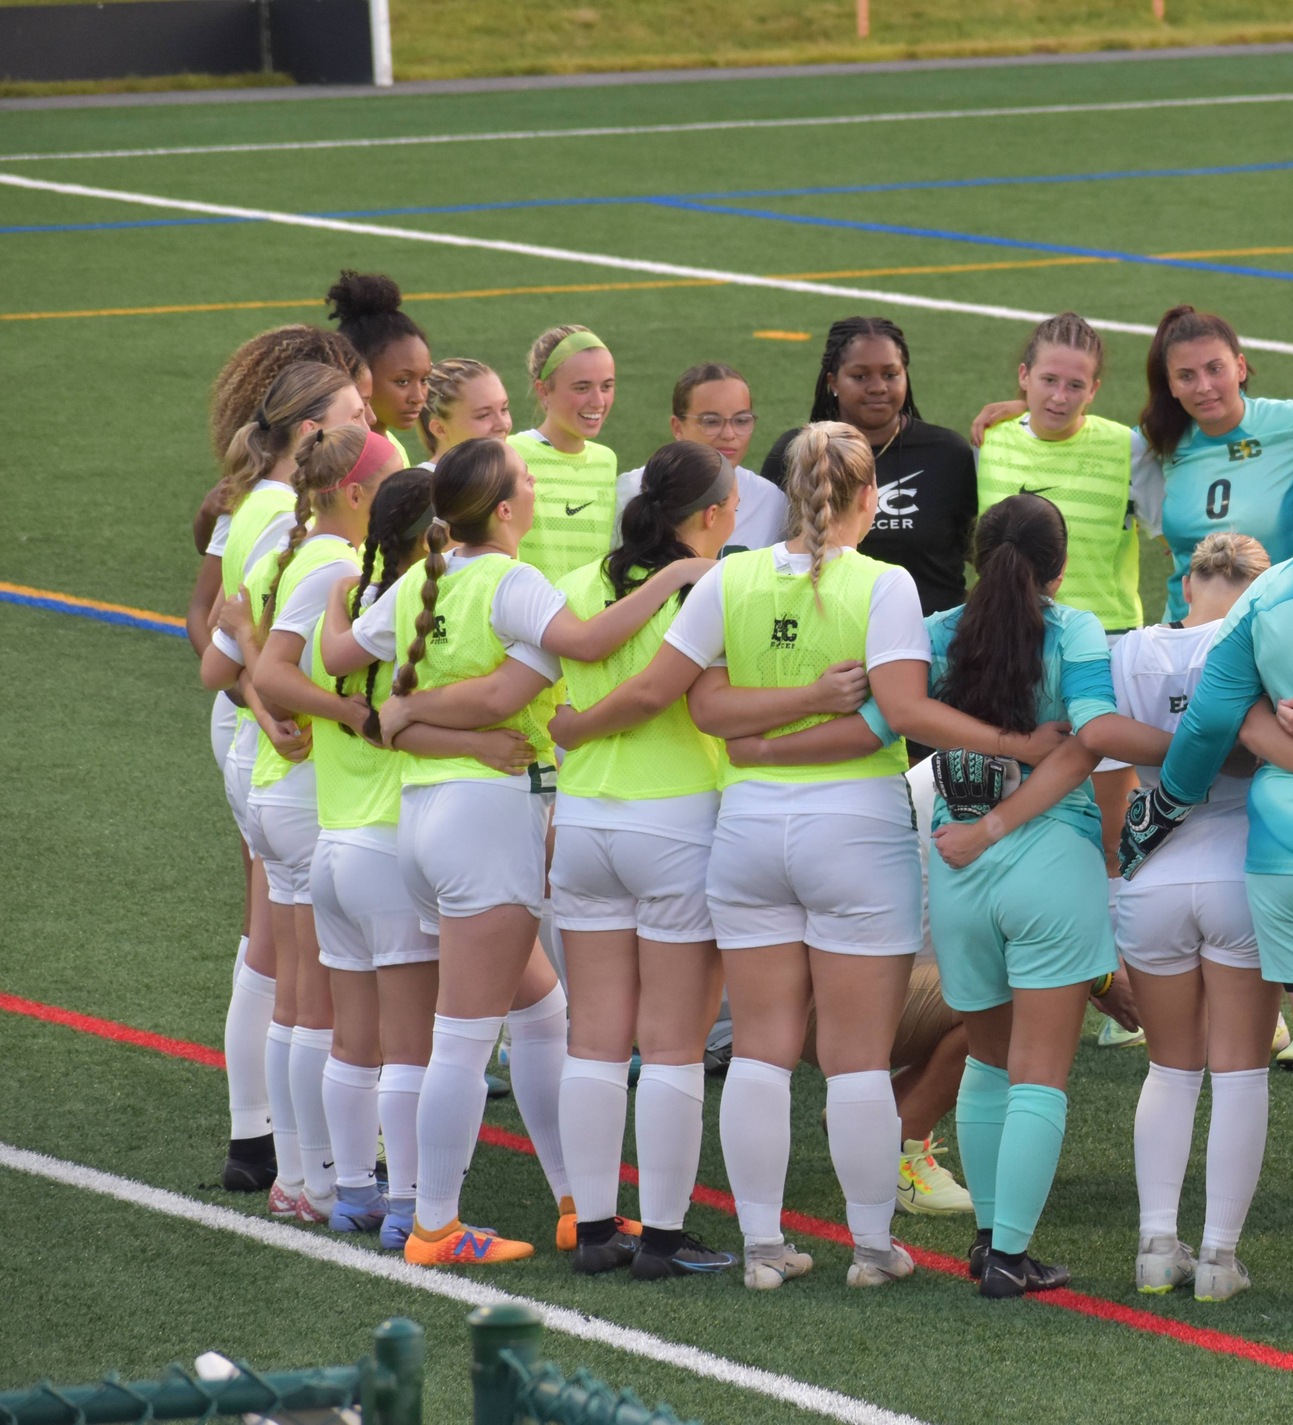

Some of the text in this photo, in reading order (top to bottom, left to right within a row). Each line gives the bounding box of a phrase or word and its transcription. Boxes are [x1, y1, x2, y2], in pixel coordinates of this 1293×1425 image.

[1227, 439, 1262, 462] EC
[1206, 478, 1231, 520] 0
[771, 617, 798, 642] EC
[453, 1231, 493, 1259] N
